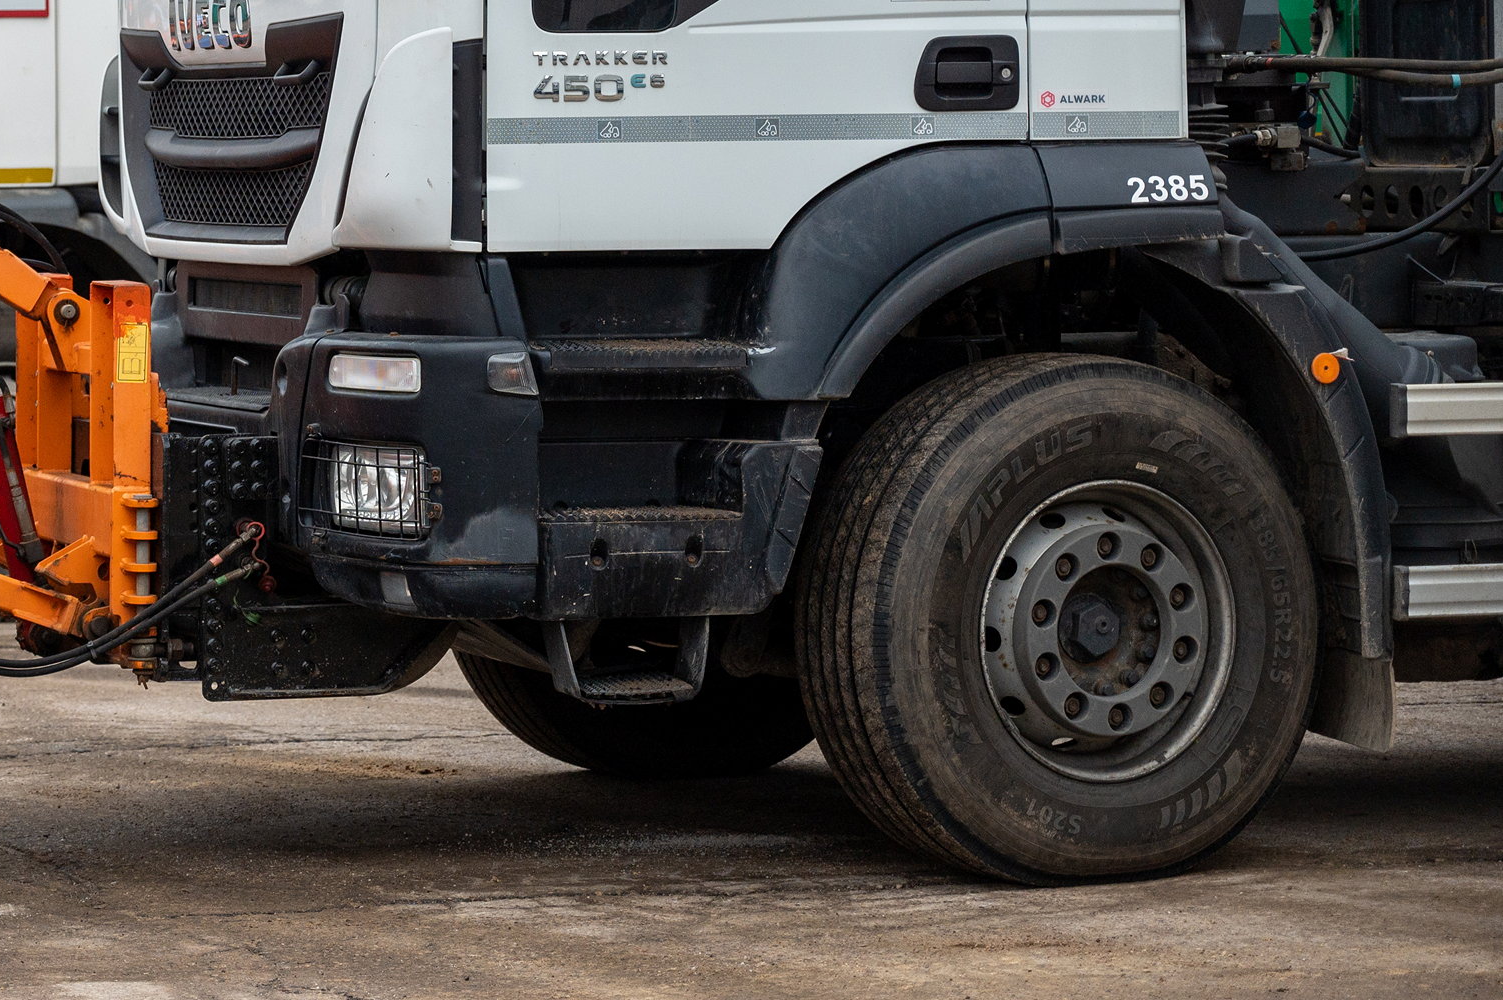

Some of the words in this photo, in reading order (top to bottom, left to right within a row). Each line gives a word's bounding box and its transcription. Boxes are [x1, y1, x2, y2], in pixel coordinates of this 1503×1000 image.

[532, 50, 669, 67] TRAKKER
[533, 73, 625, 103] 450
[1060, 94, 1106, 105] ALWARK
[1127, 174, 1210, 204] 2385
